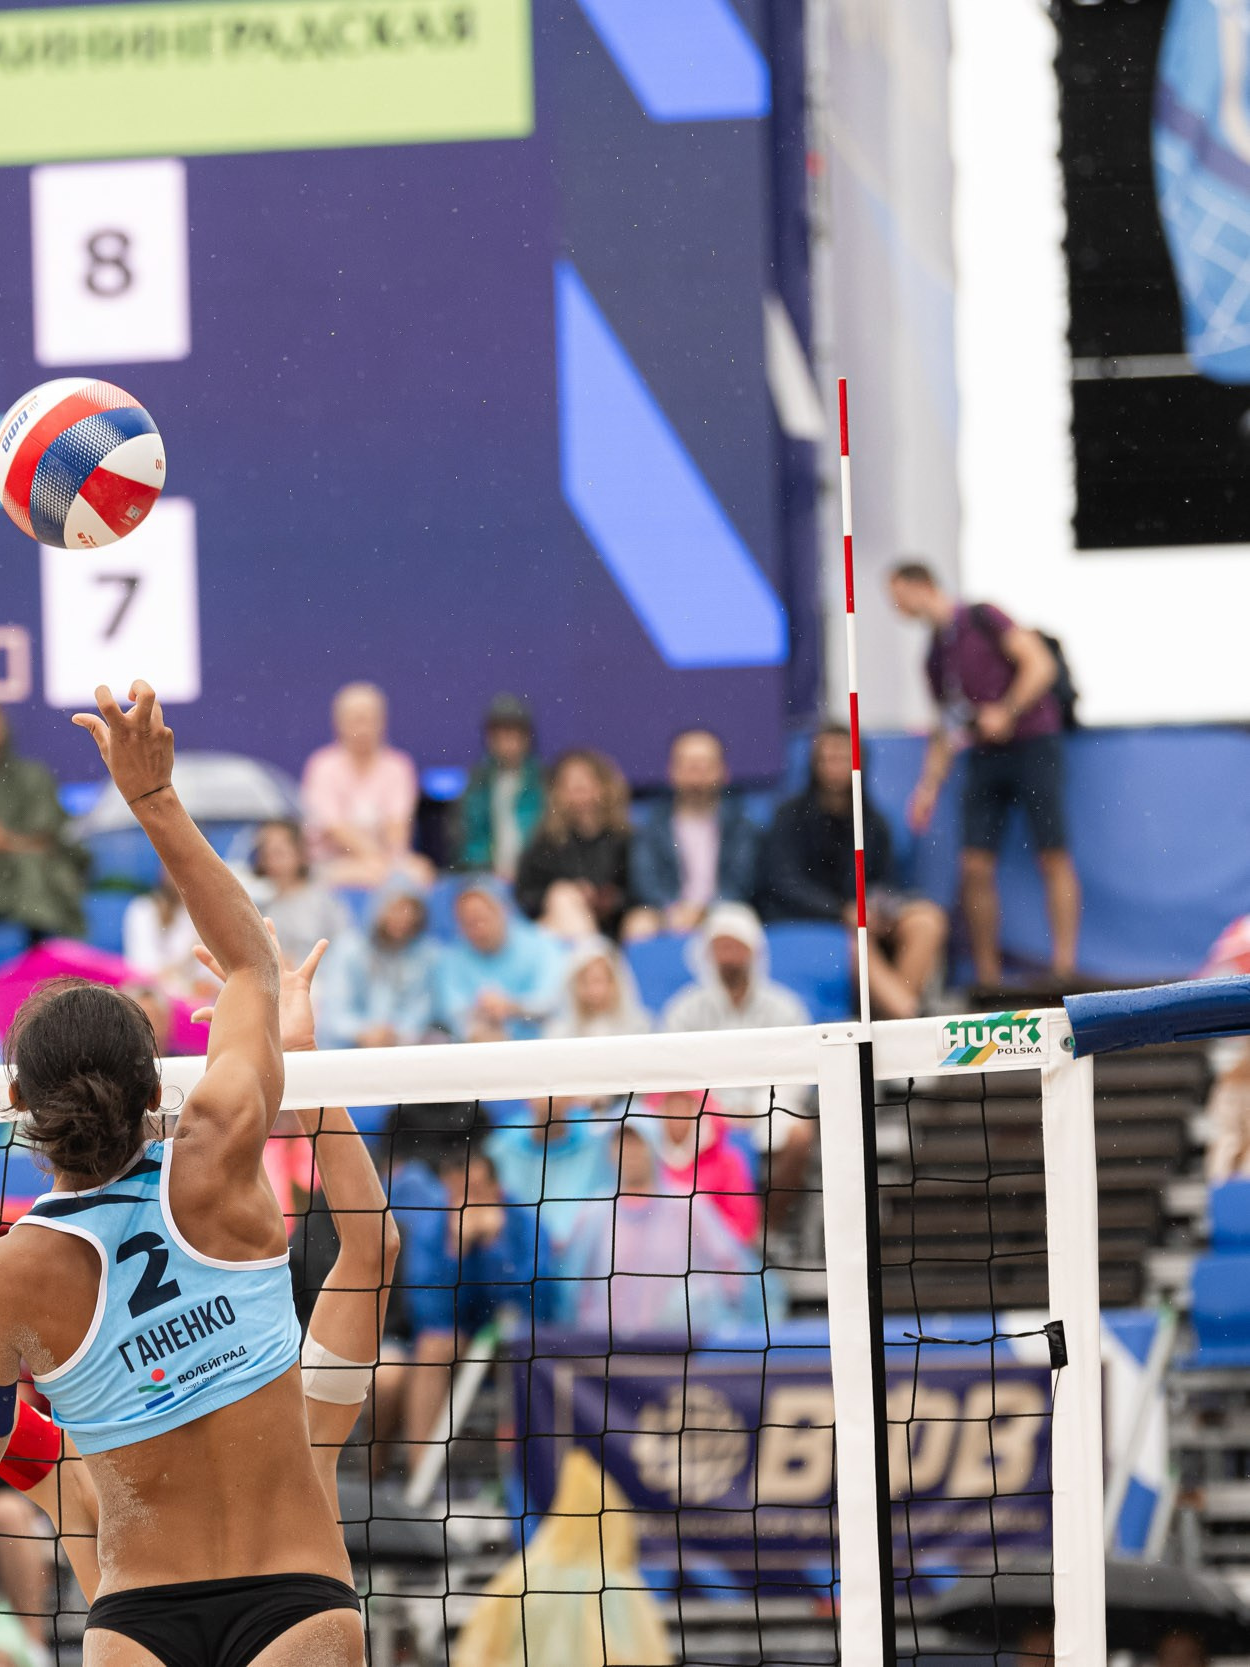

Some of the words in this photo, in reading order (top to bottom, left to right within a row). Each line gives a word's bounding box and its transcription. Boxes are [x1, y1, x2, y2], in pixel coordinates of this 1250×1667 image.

[83, 229, 135, 300] 8
[91, 570, 141, 642] 7
[942, 1018, 1041, 1048] HUCK
[997, 1046, 1042, 1056] POLSKA
[116, 1231, 181, 1319] 2
[118, 1295, 236, 1373] ГАНЕНКО
[177, 1345, 247, 1384] ВОЛЕЙГРАД
